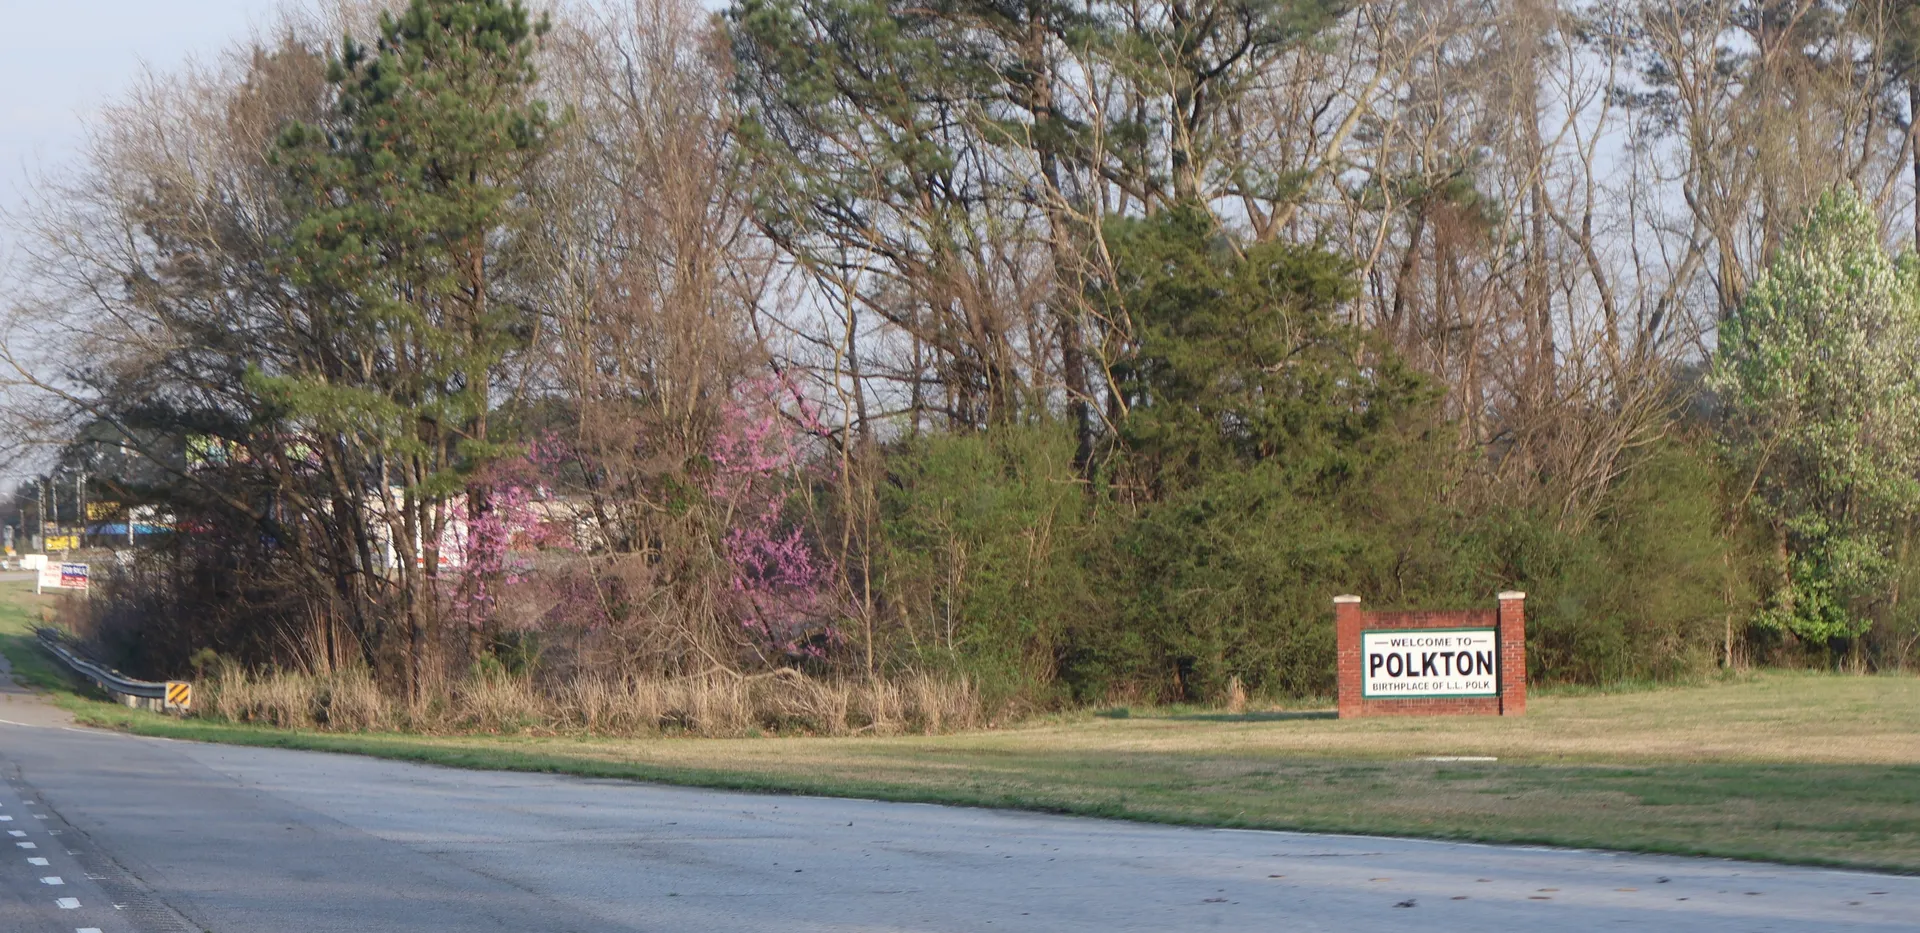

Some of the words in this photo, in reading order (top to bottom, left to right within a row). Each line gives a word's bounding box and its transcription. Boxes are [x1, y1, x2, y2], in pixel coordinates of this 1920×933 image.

[1391, 638, 1452, 647] WELCOME
[1456, 637, 1472, 646] TO
[1370, 651, 1492, 678] POLKTON
[1372, 682, 1429, 691] BIRTHPLACE
[1432, 682, 1444, 690] OF
[1446, 681, 1463, 690] L.L.
[1466, 681, 1490, 689] POLK
